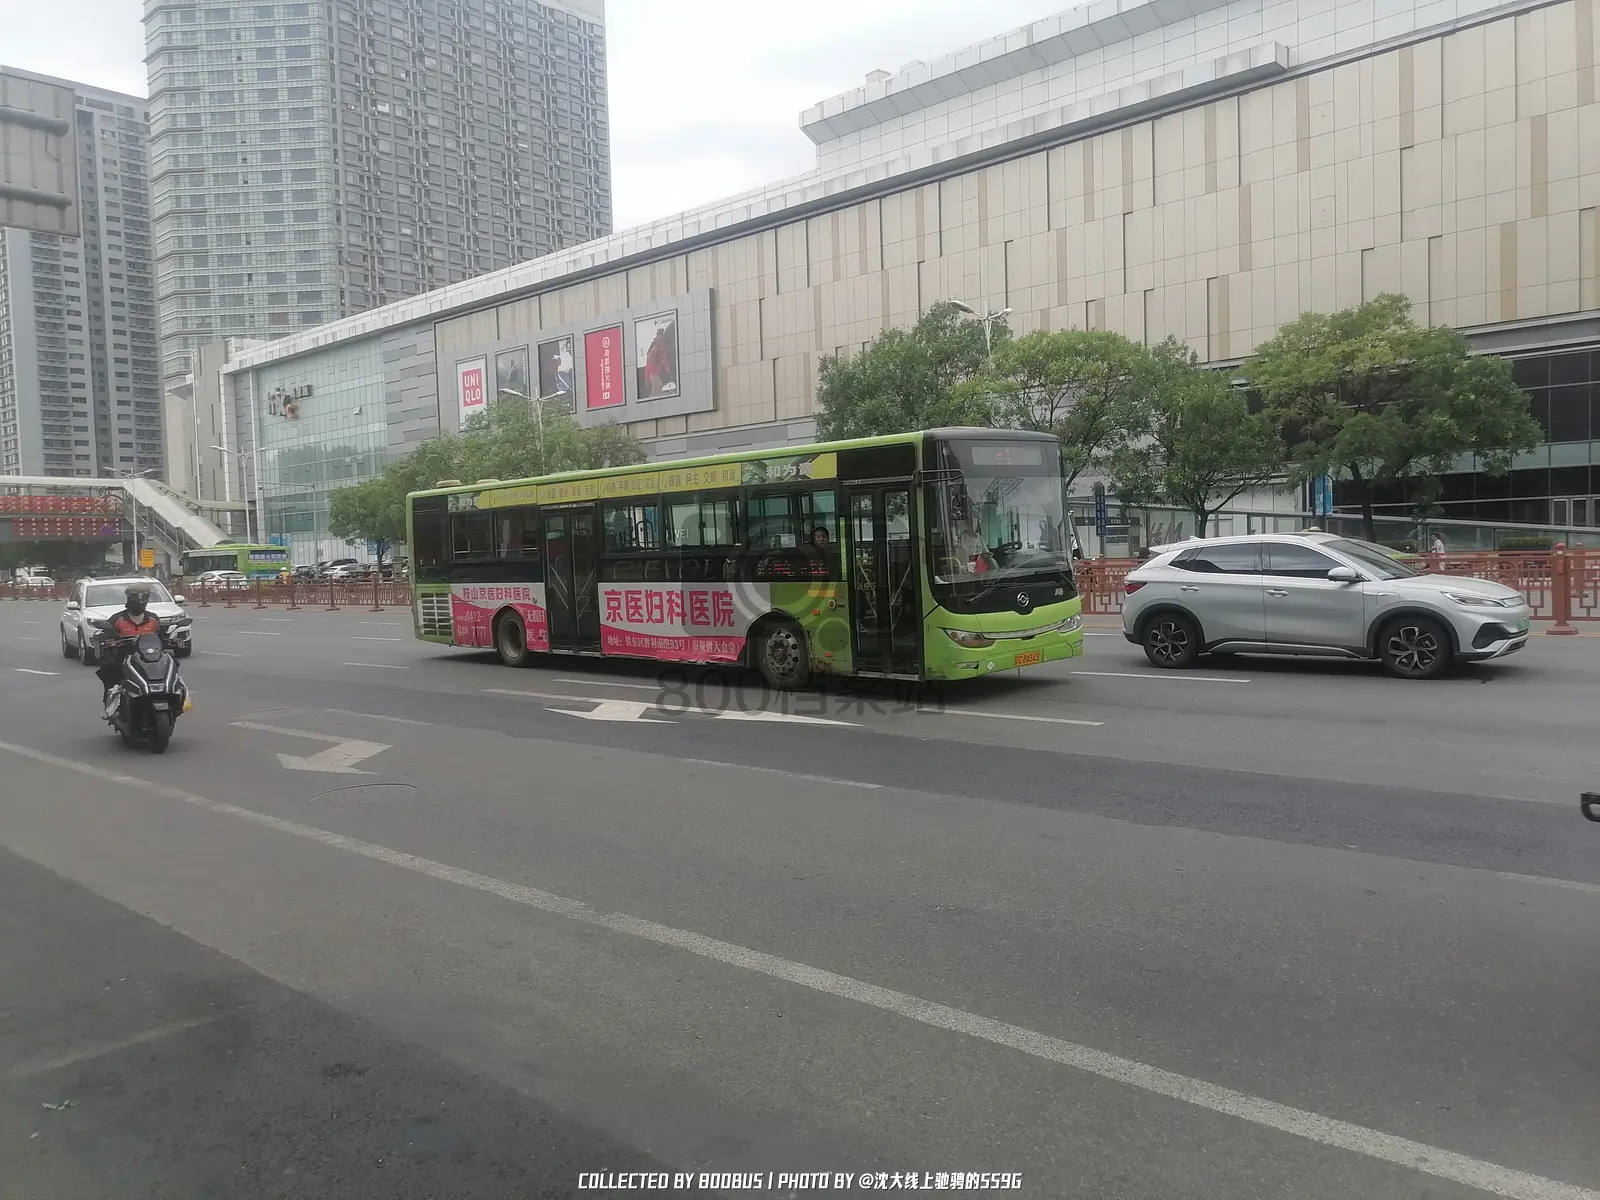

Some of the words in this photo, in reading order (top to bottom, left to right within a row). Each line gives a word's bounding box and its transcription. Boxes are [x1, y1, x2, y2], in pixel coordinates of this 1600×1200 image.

[464, 373, 479, 387] UNI
[465, 388, 481, 404] QLO
[685, 471, 699, 486] 民主
[703, 470, 717, 484] 文明
[721, 467, 736, 481] 和谐
[462, 587, 532, 601] 鞍山京医妇科医院
[603, 589, 736, 628] 京医妇科医院
